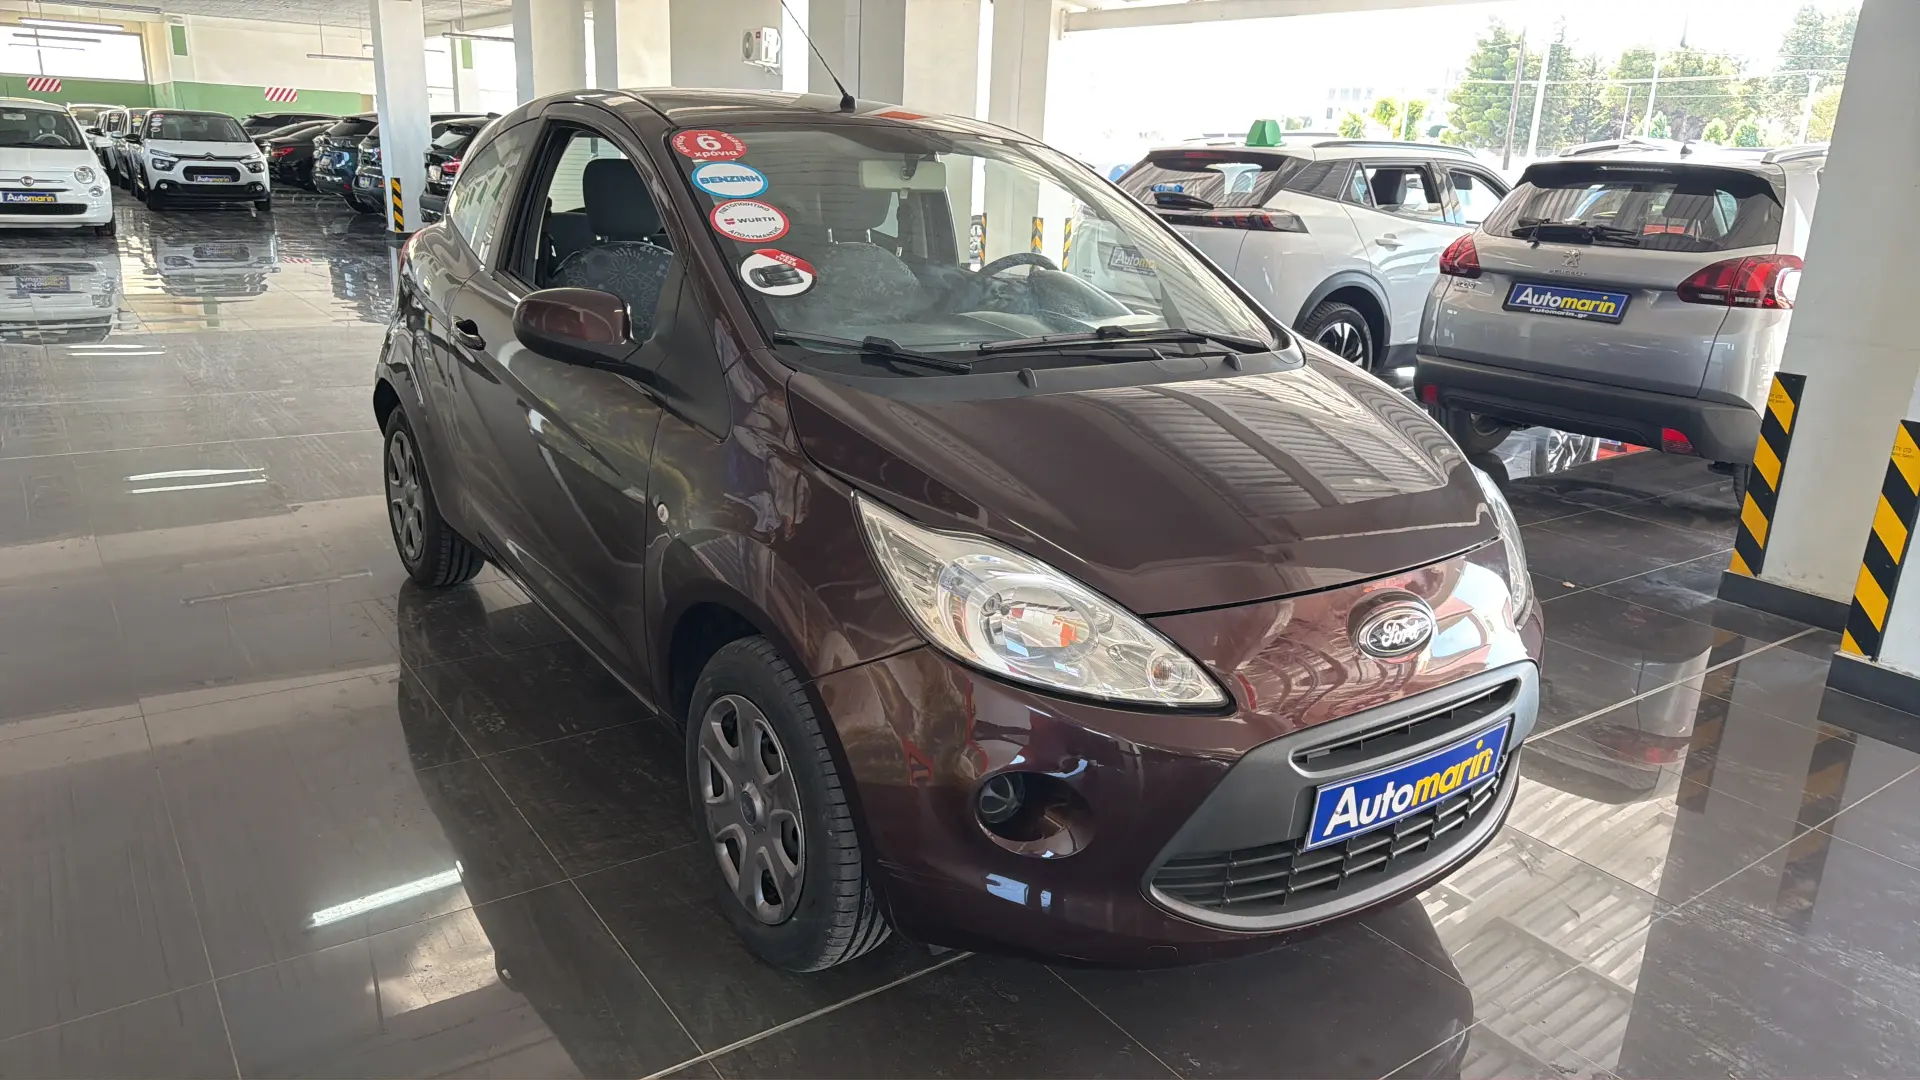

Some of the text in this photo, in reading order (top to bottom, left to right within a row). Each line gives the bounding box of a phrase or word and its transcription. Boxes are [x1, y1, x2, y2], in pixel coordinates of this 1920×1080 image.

[696, 136, 721, 150] 6
[7, 193, 55, 202] Automarin
[1515, 287, 1616, 313] Automarin
[1530, 307, 1588, 319] Automarin.gr
[1381, 617, 1419, 648] Ford
[1323, 739, 1494, 837] Automarin
